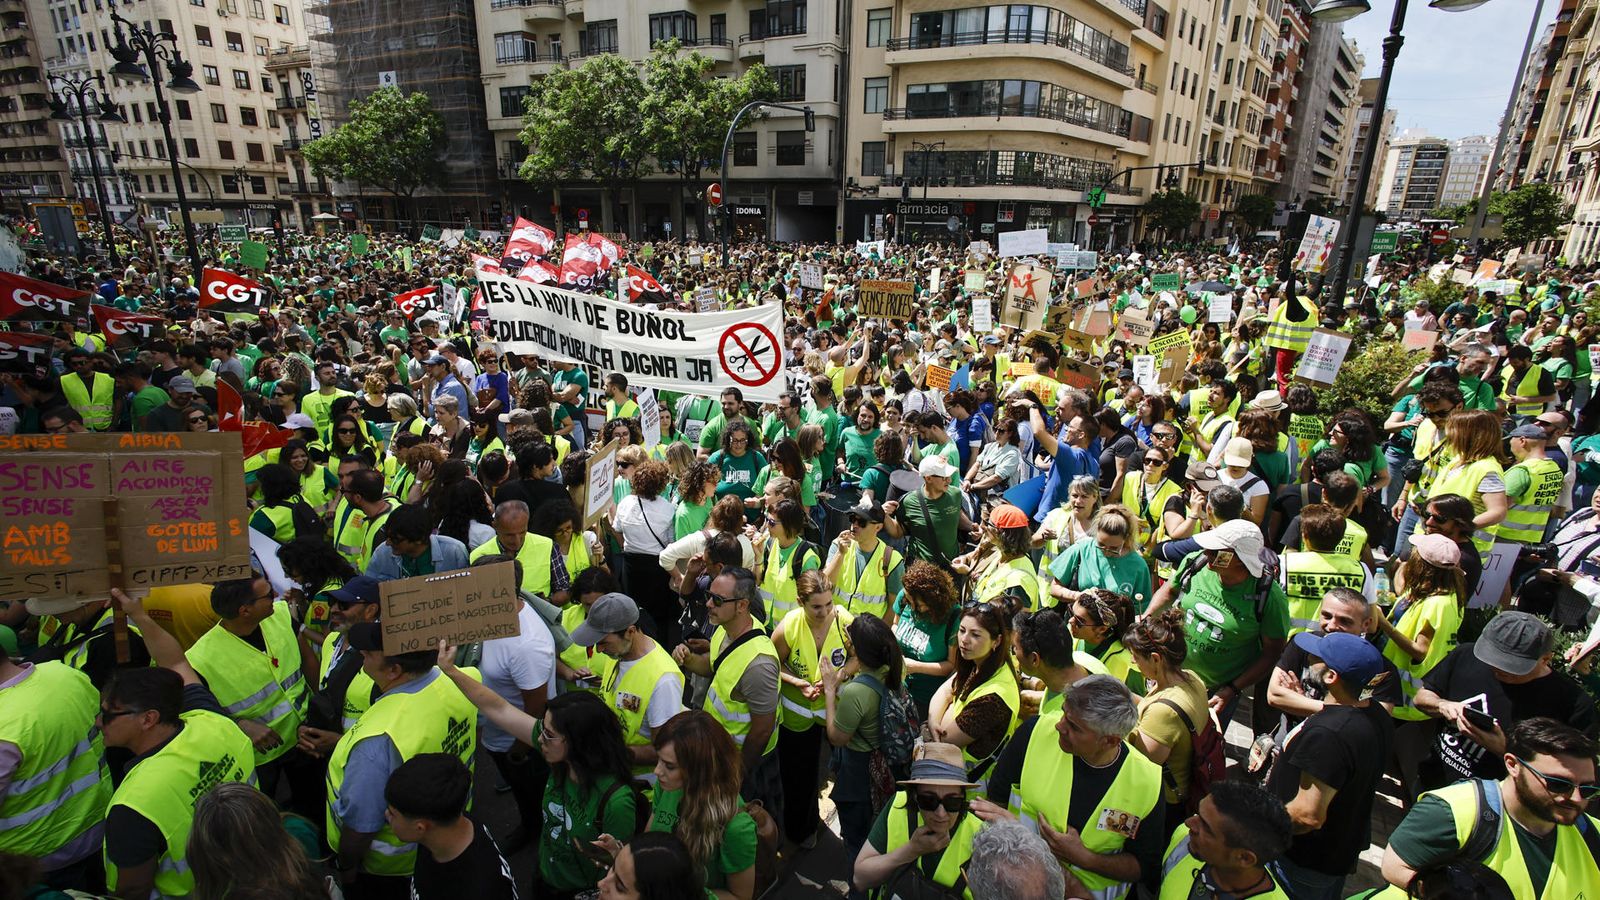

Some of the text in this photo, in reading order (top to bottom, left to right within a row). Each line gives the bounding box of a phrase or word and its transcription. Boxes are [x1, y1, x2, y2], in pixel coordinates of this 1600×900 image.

[896, 202, 949, 215] farmacia
[12, 288, 76, 316] CGT
[207, 280, 268, 307] CGT
[401, 292, 437, 316] CGT
[859, 290, 913, 318] SENSE PROFES
[479, 280, 697, 341] IES LA HOYA DE BUÑOL
[106, 318, 154, 338] CGT
[489, 319, 557, 351] EDUCACIÓ
[559, 332, 615, 370] PÚBLICA
[621, 350, 679, 379] DIGNA
[686, 357, 712, 383] JA
[1154, 334, 1183, 348] ESCOLES
[0, 433, 182, 449] SENSE AIGUA
[121, 459, 185, 473] AIRE
[1, 463, 96, 491] SENSE
[118, 476, 214, 492] ACONDICIO
[2, 497, 76, 517] SENSE
[150, 496, 209, 508] ASCEN
[160, 507, 202, 521] SOR
[4, 520, 72, 548] AMB
[156, 538, 179, 553] DE
[4, 547, 73, 566] TALLS
[132, 563, 250, 584] CIPFP XEST
[1288, 574, 1361, 588] ENS FALTA
[1301, 586, 1320, 597] DE
[388, 587, 510, 618] ESTUDIÉ EN LA
[385, 601, 515, 635] ESCUELA DE MAGISTERIO
[400, 622, 516, 653] NO EN HOGWARTS
[189, 753, 229, 798] DOCENT
[1444, 756, 1472, 778] QUALITAT
